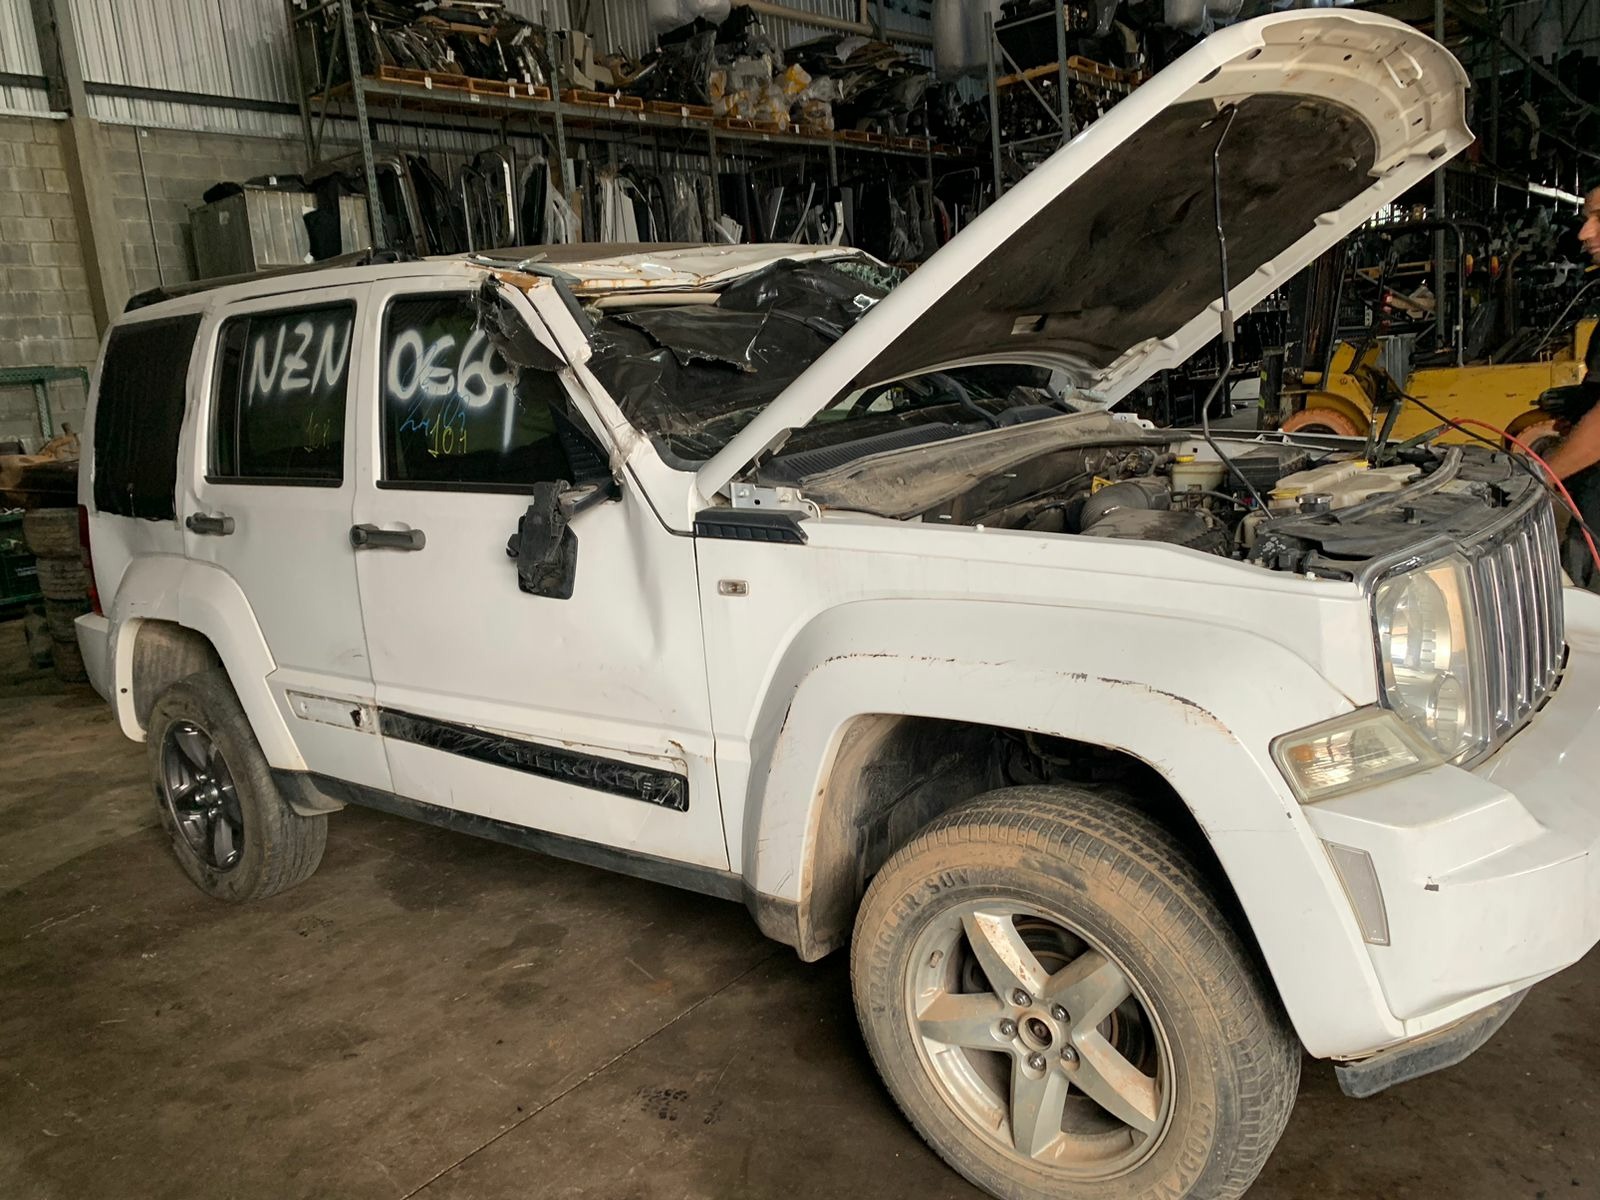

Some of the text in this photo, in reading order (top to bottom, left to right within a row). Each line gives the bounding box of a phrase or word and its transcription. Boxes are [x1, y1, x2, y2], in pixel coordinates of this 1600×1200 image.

[247, 319, 352, 406] NZN
[497, 747, 654, 796] CHEROKEE
[925, 868, 970, 894] SUV
